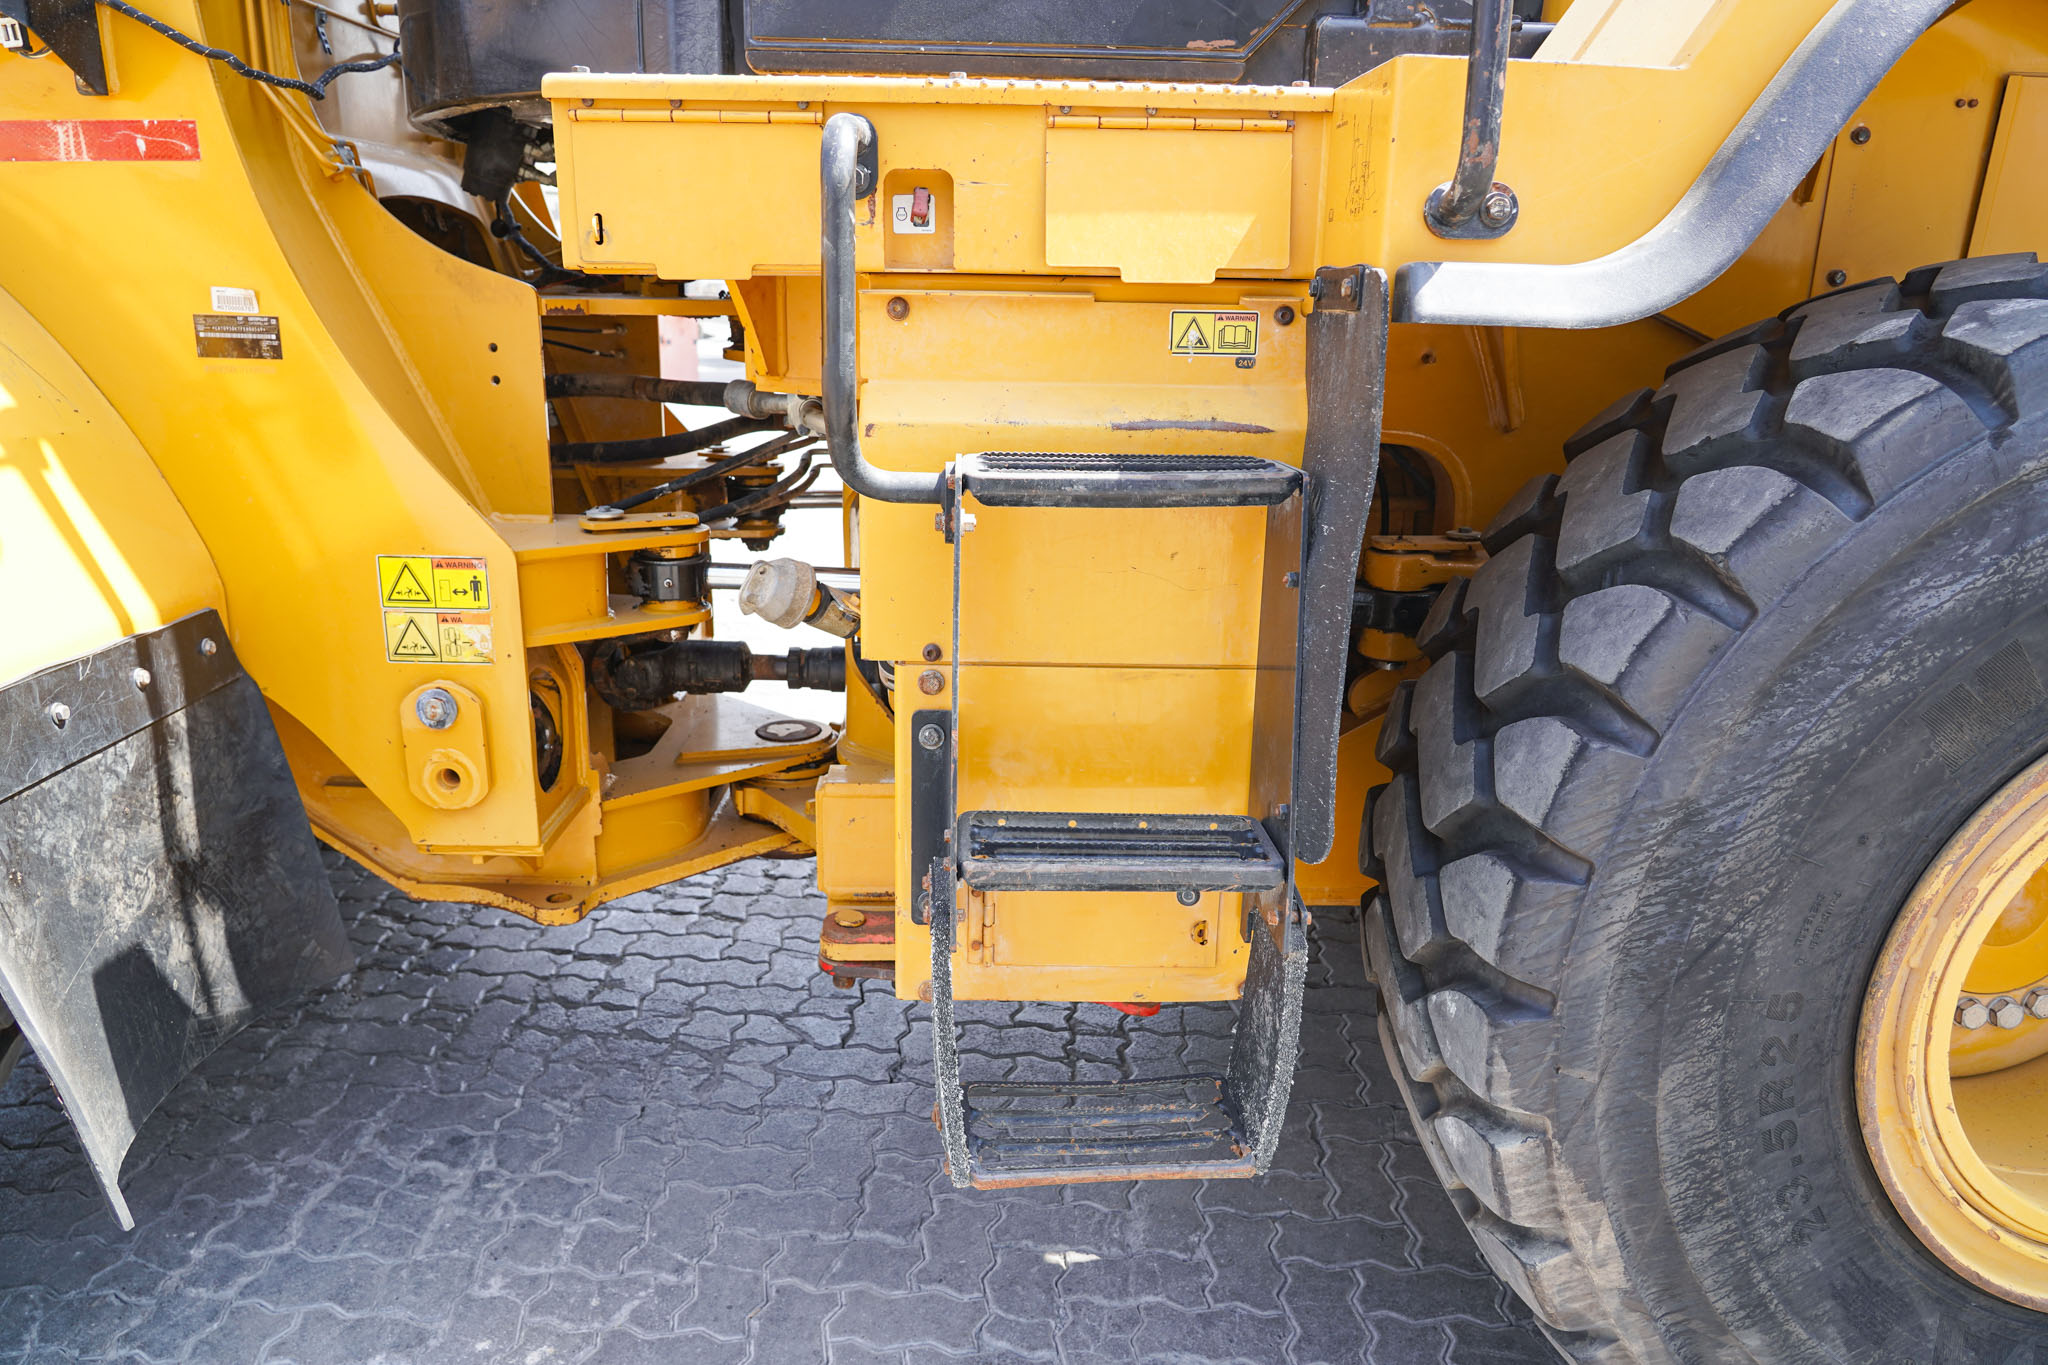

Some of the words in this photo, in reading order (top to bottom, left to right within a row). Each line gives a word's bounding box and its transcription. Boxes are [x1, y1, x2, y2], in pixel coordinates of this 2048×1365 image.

[1238, 359, 1254, 367] 24V
[445, 561, 483, 569] WARNING
[1758, 991, 1830, 1248] 23.5R25
